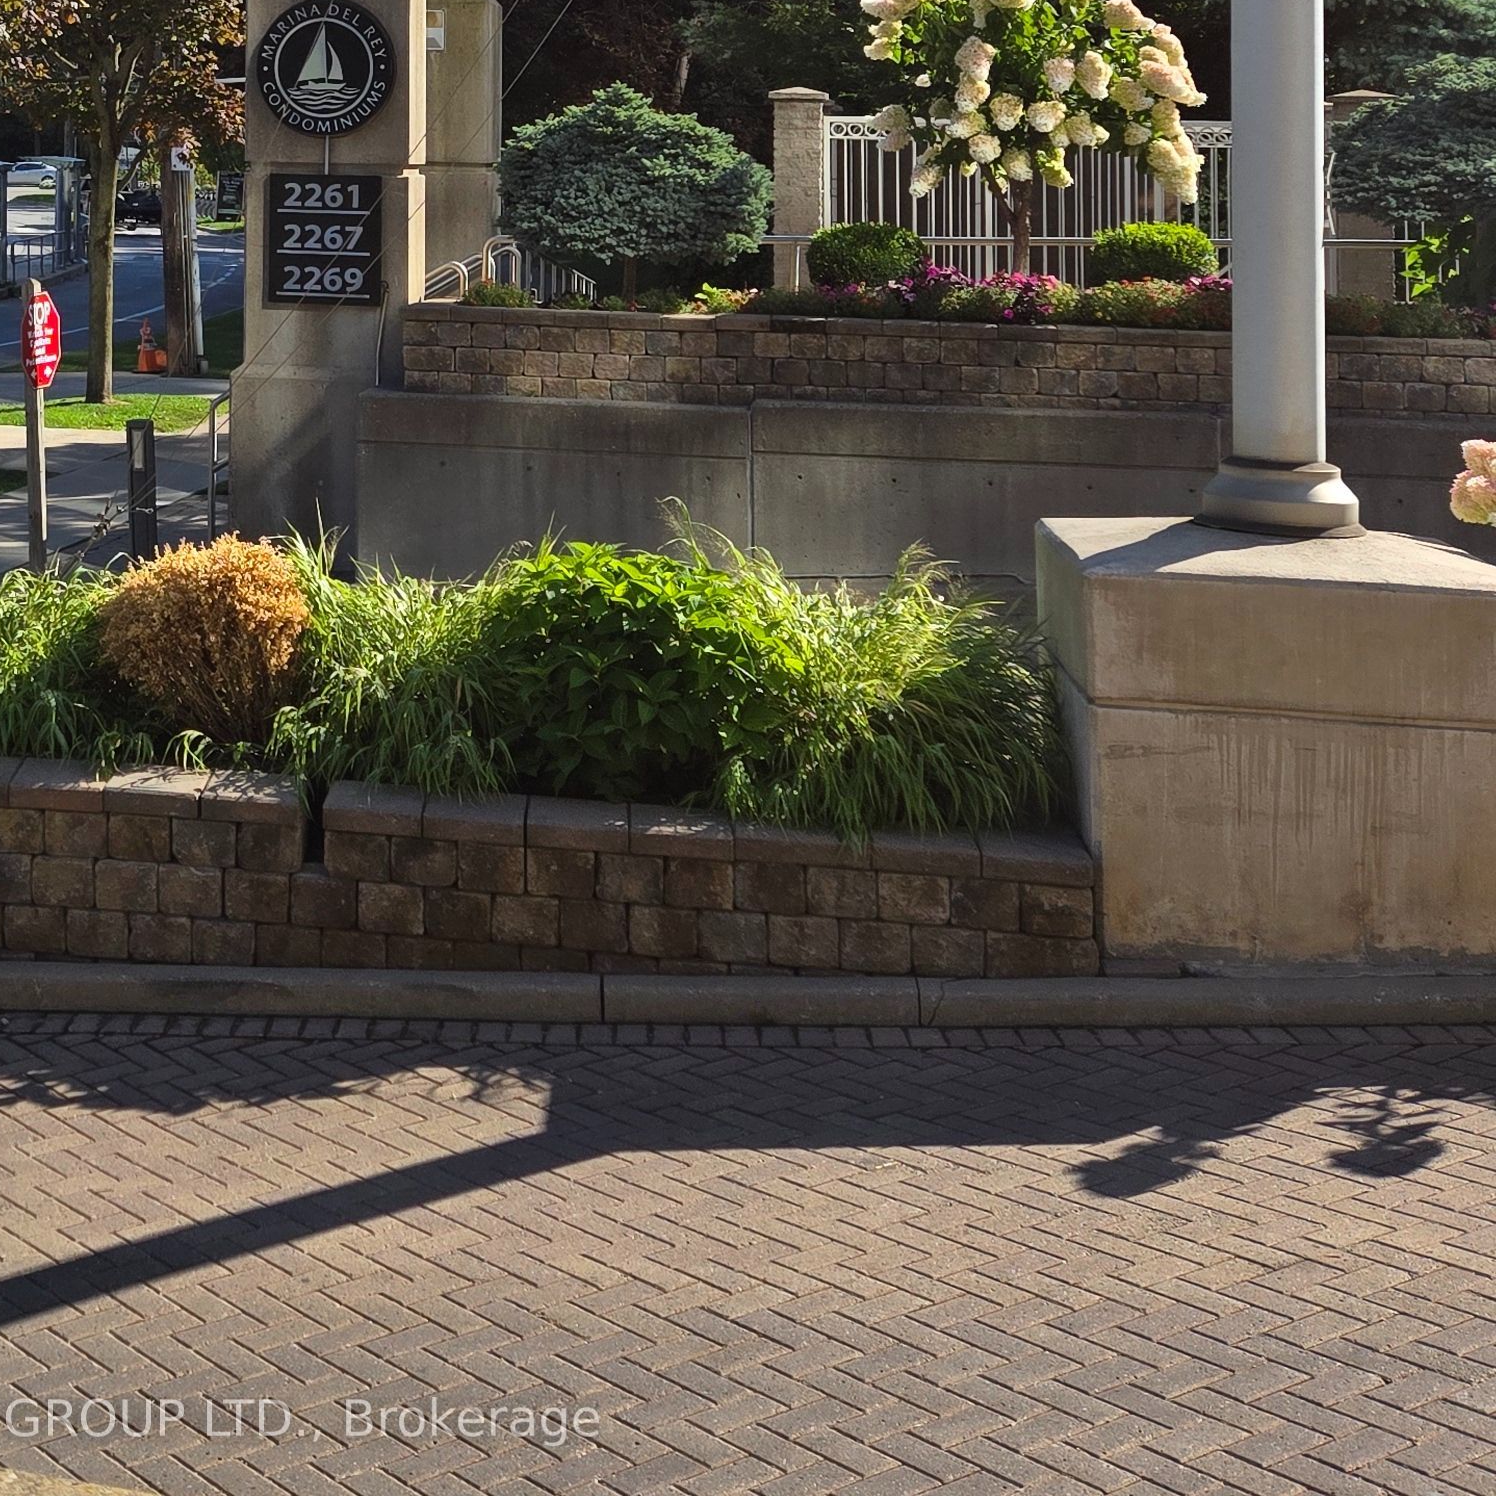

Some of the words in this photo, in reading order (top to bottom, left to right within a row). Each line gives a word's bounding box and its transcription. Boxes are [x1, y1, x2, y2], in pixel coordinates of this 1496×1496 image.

[261, 4, 321, 60] MARINA
[328, 4, 360, 26] DEL
[364, 25, 387, 58] REY
[264, 81, 386, 133] CONDOMINIUMS
[284, 183, 360, 208] 2261
[283, 224, 364, 250] 2267
[283, 265, 364, 291] 2269
[28, 301, 51, 326] STOP
